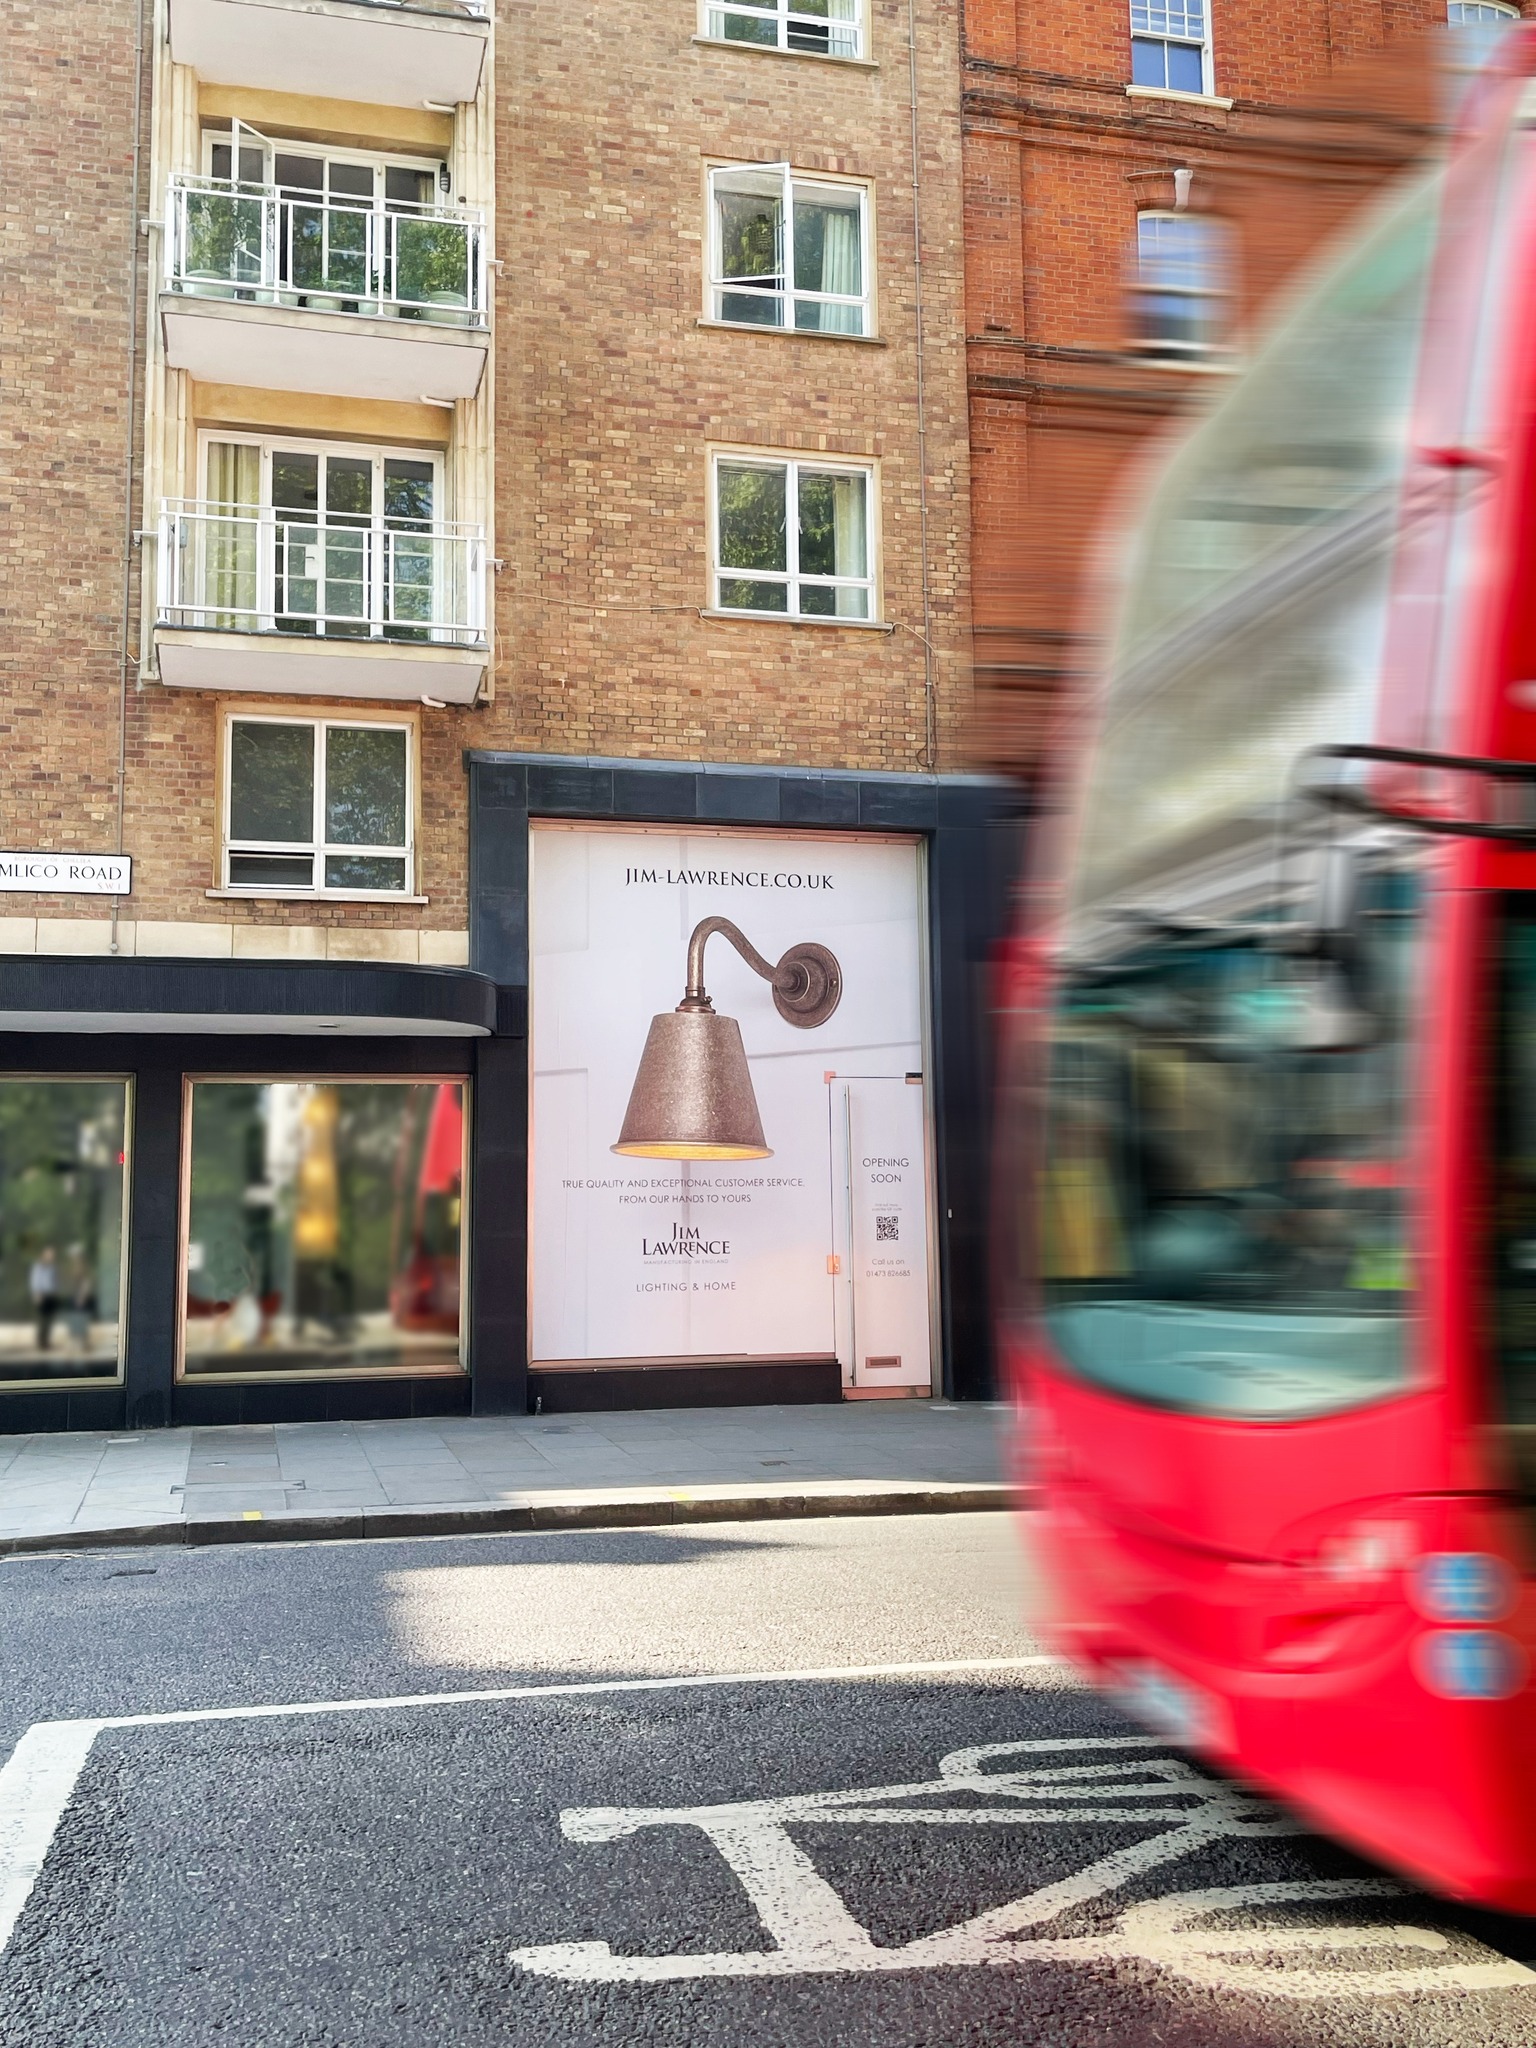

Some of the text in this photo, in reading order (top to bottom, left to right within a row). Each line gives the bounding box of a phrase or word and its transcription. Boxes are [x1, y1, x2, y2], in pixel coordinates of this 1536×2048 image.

[0, 864, 122, 880] MLICO ROAD
[626, 868, 834, 889] JIM-LAWRENCE.CO.UK
[862, 1157, 909, 1168] OPENING
[562, 1180, 584, 1188] TRUE
[586, 1180, 624, 1188] QUALITY
[627, 1179, 648, 1188] AND
[651, 1178, 712, 1188] EXCEPTIONAL
[715, 1178, 764, 1187] CUSTOMER
[871, 1173, 902, 1183] SOON
[619, 1194, 752, 1204] FROM OUR HANDS TO YOURS
[672, 1222, 700, 1242] JIM
[642, 1238, 731, 1258] LAWRENCE
[871, 1258, 886, 1266] Call
[636, 1281, 736, 1292] LIGHTING & HOME
